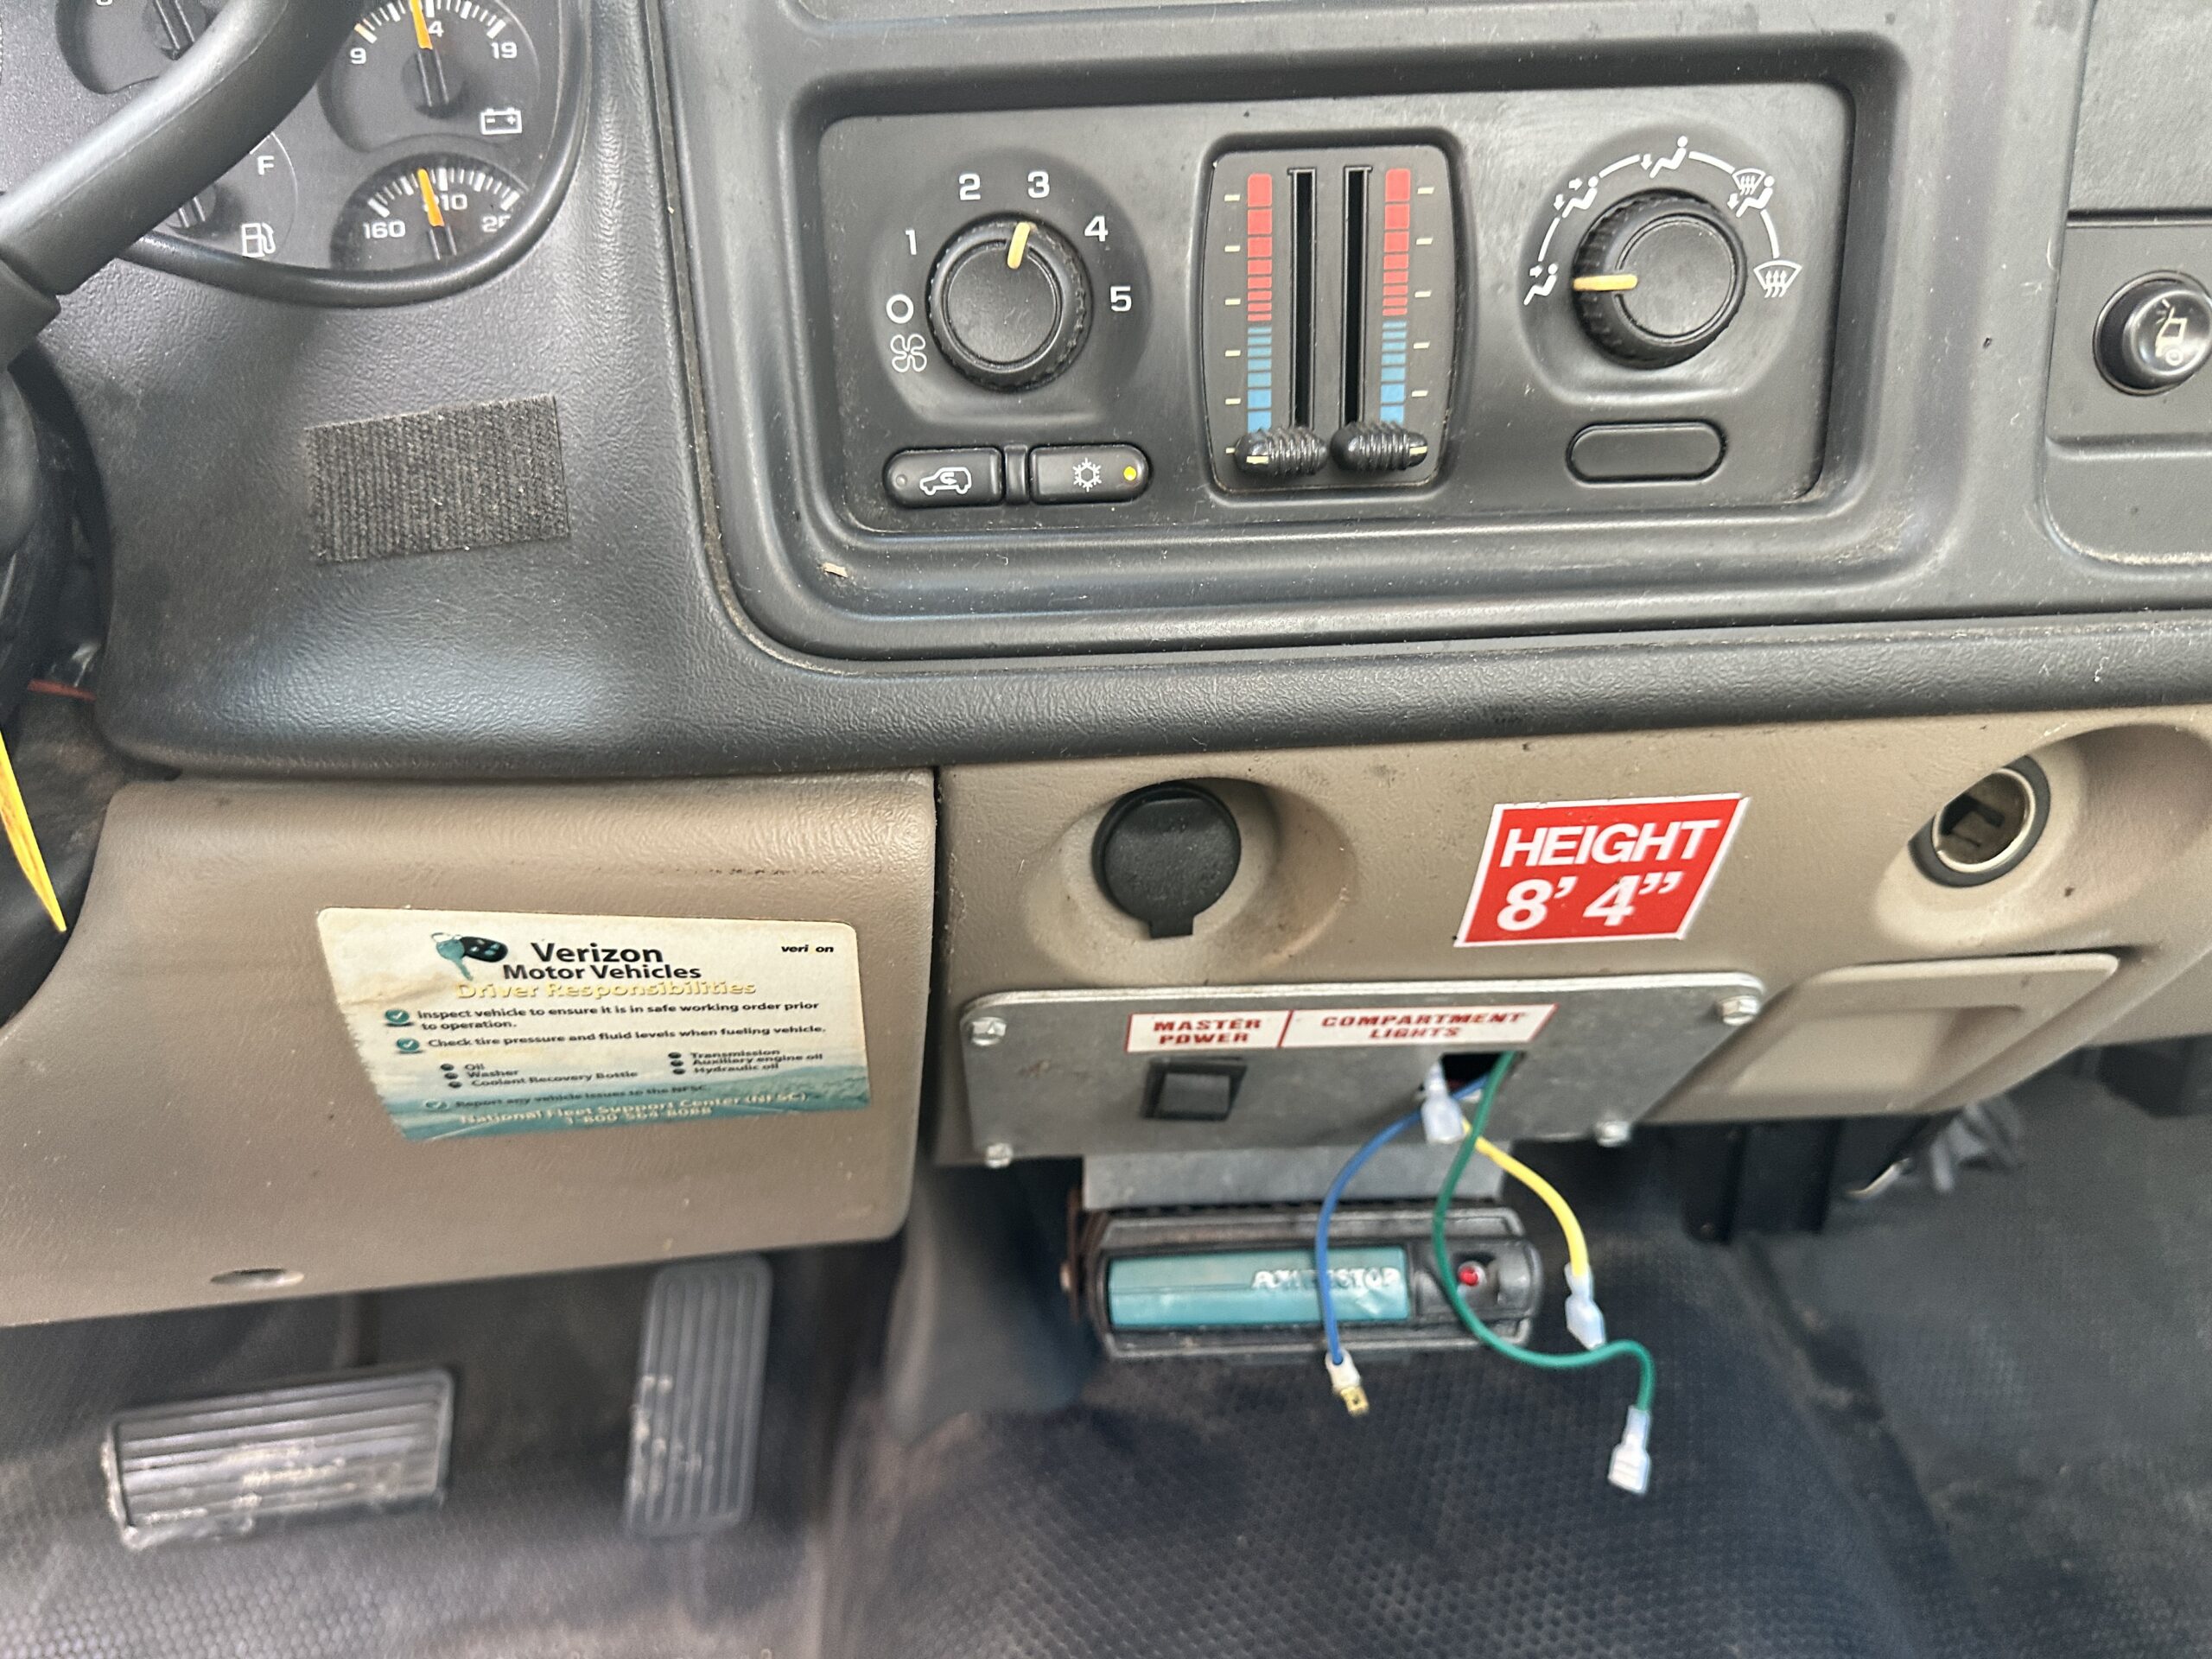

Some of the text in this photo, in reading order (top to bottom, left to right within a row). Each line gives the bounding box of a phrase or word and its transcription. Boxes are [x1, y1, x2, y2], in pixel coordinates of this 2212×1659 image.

[349, 47, 367, 65] 9
[490, 41, 518, 60] 19
[257, 156, 275, 175] F
[958, 173, 982, 200] 2
[1027, 170, 1051, 199] 3
[363, 219, 406, 239] 160
[1084, 215, 1109, 242] 4
[905, 229, 918, 256] 1
[1109, 285, 1133, 313] 5
[1499, 819, 1722, 868] HEIGHT
[1497, 870, 1685, 931] 8' 4"
[531, 942, 664, 963] Verizon
[781, 944, 835, 953] verion
[503, 964, 702, 980] Motor Vehicles
[455, 980, 757, 1000] Driver Responsibilities
[417, 1001, 820, 1020] Inspect vehicle to ensure it is in safe working order prior
[1320, 1012, 1528, 1027] COMPARTMENT
[422, 1020, 518, 1032] to operation.
[1154, 1018, 1262, 1032] MASTER
[1368, 1027, 1461, 1039] LIGHTS
[428, 1025, 827, 1047] Check tire pressure and fluid levels when fueling vehicle.
[1160, 1032, 1249, 1045] POWER
[691, 1049, 781, 1059] Transmission
[806, 1052, 823, 1061] oil
[464, 1063, 485, 1071] Oil
[467, 1068, 519, 1078] Washer
[694, 1064, 760, 1075] Hydraulic
[472, 1070, 639, 1087] Coolant Recovery Bottle
[455, 1097, 502, 1109] Report
[461, 1109, 543, 1125] National
[546, 1106, 592, 1118] Fleet
[596, 1102, 674, 1115] Support
[680, 1096, 740, 1109] Center
